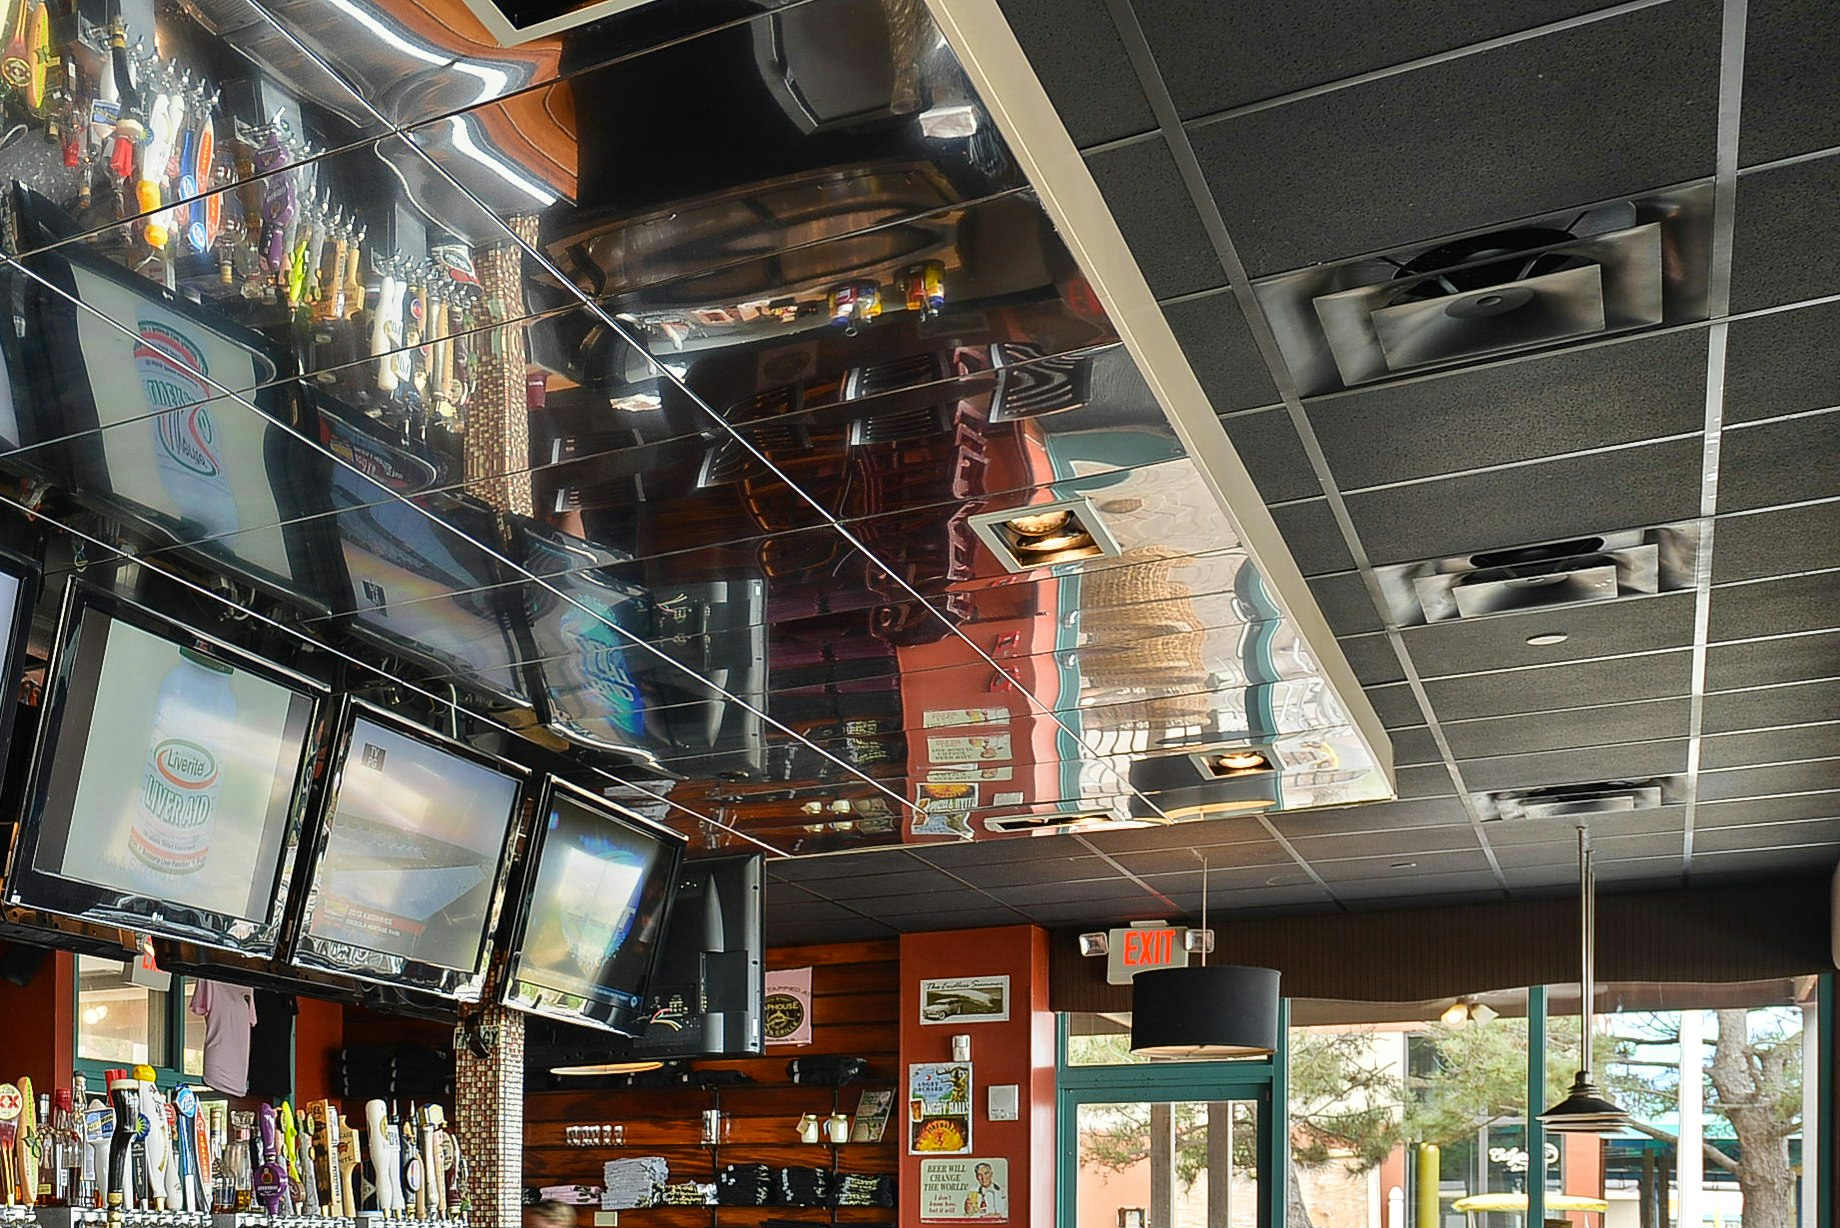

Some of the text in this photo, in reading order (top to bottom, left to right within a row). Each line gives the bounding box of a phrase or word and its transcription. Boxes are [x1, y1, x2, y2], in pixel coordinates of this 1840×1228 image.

[167, 748, 206, 777] Liverite
[1123, 929, 1177, 966] EXIT
[927, 1164, 968, 1173] BEER WILL
[929, 1174, 961, 1182] CHANGE
[923, 1183, 939, 1191] THE
